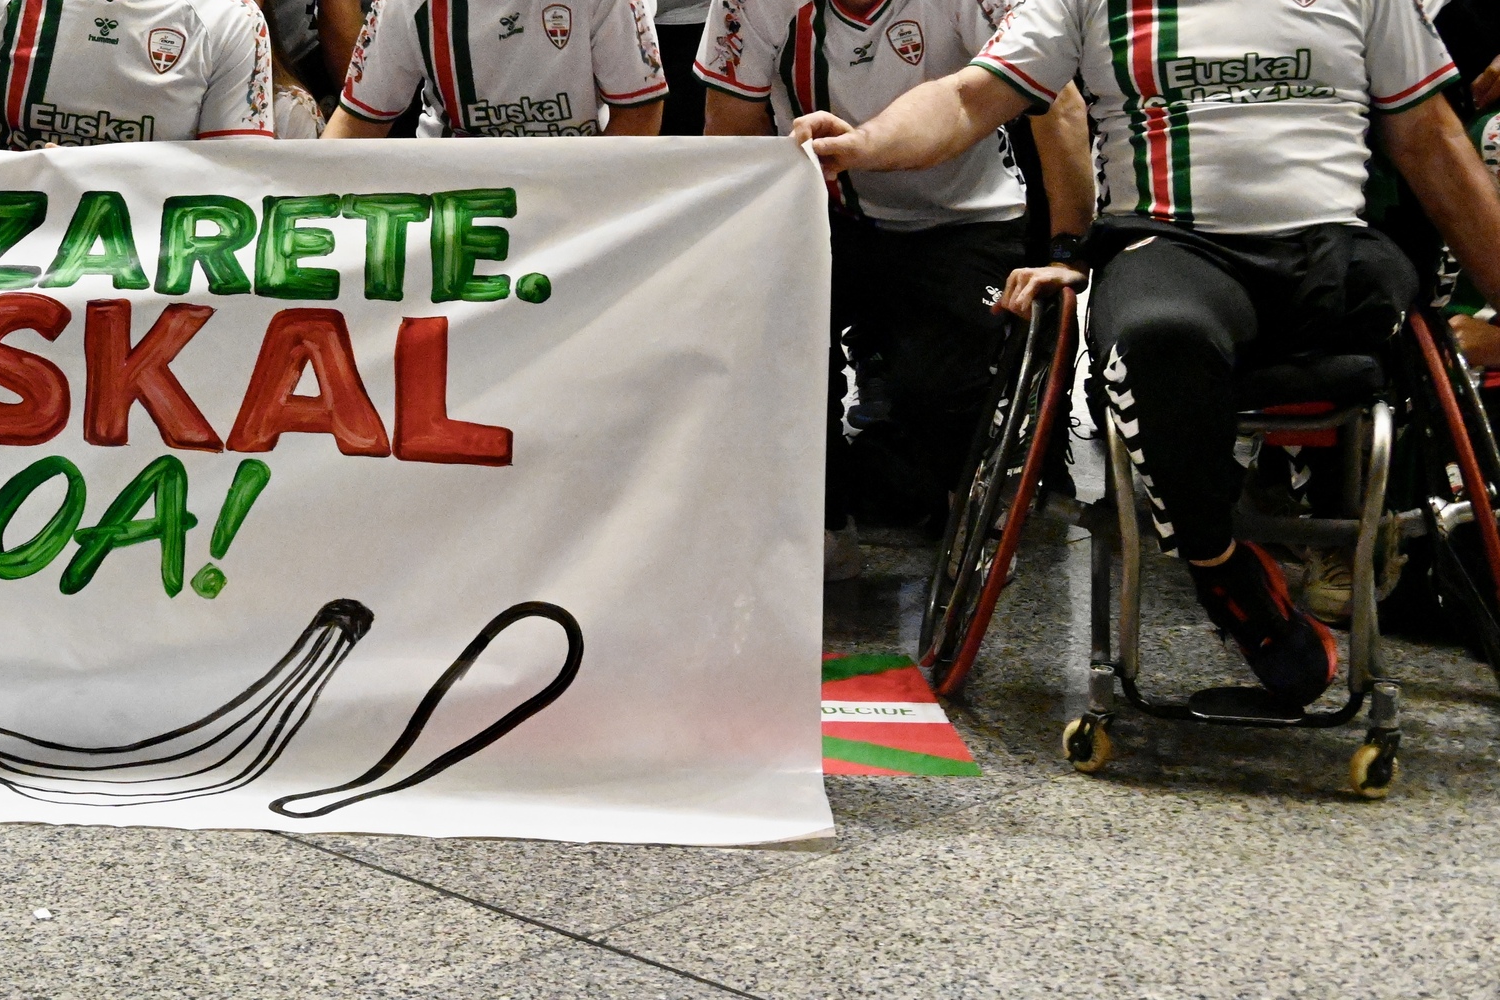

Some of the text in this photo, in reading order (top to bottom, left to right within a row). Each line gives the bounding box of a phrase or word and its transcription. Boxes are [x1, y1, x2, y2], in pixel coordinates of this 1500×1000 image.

[88, 34, 119, 45] hummel
[1166, 49, 1311, 89] Euskal
[29, 102, 155, 144] Euskal
[467, 93, 573, 127] Euskal
